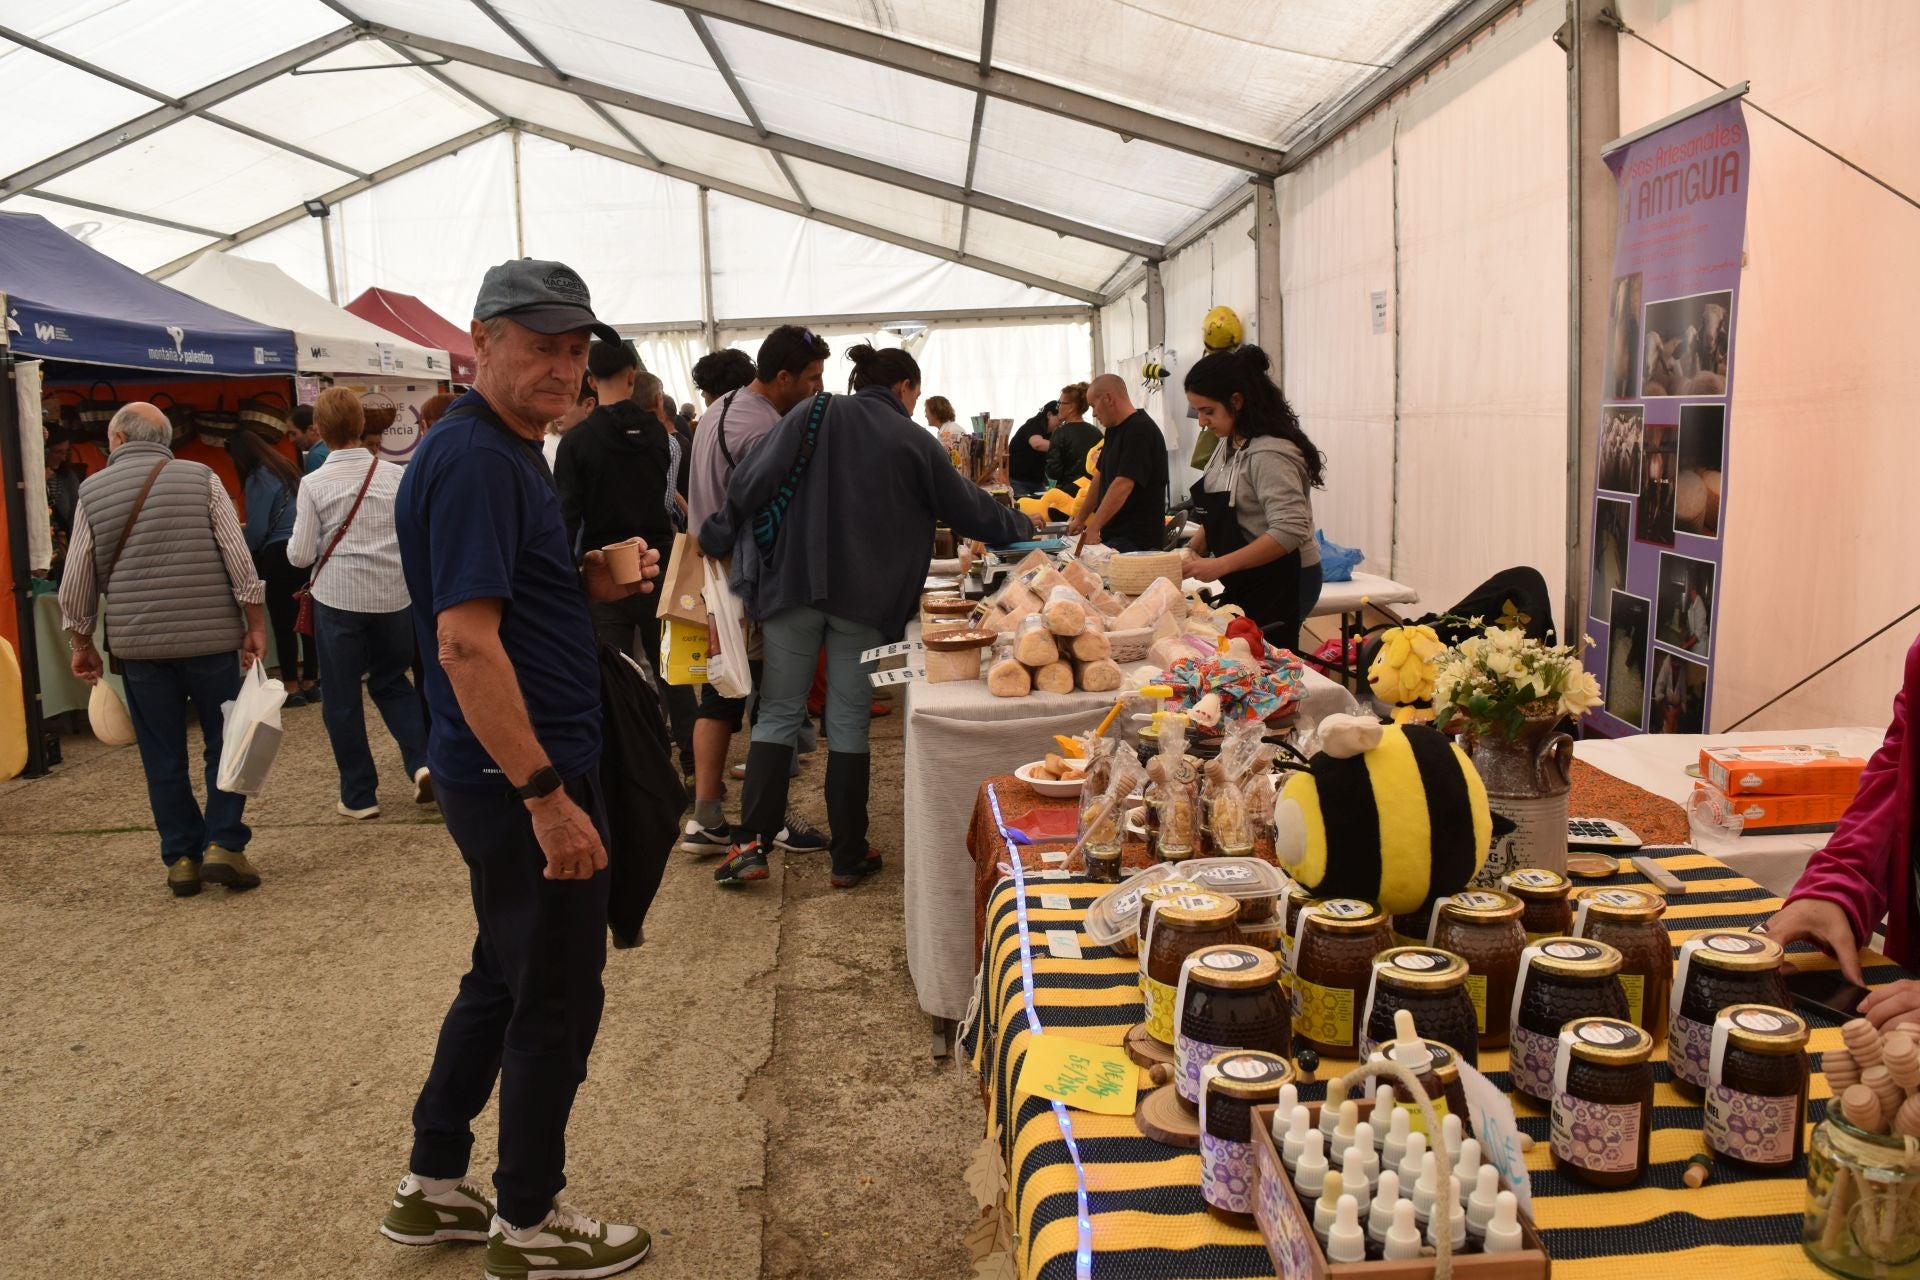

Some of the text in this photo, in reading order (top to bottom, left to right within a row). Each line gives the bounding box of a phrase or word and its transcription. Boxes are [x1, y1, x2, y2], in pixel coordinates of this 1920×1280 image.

[1656, 123, 1742, 170] Artesanales
[1638, 151, 1740, 220] ANTIGUA
[184, 350, 214, 365] palentina
[383, 424, 413, 435] encia
